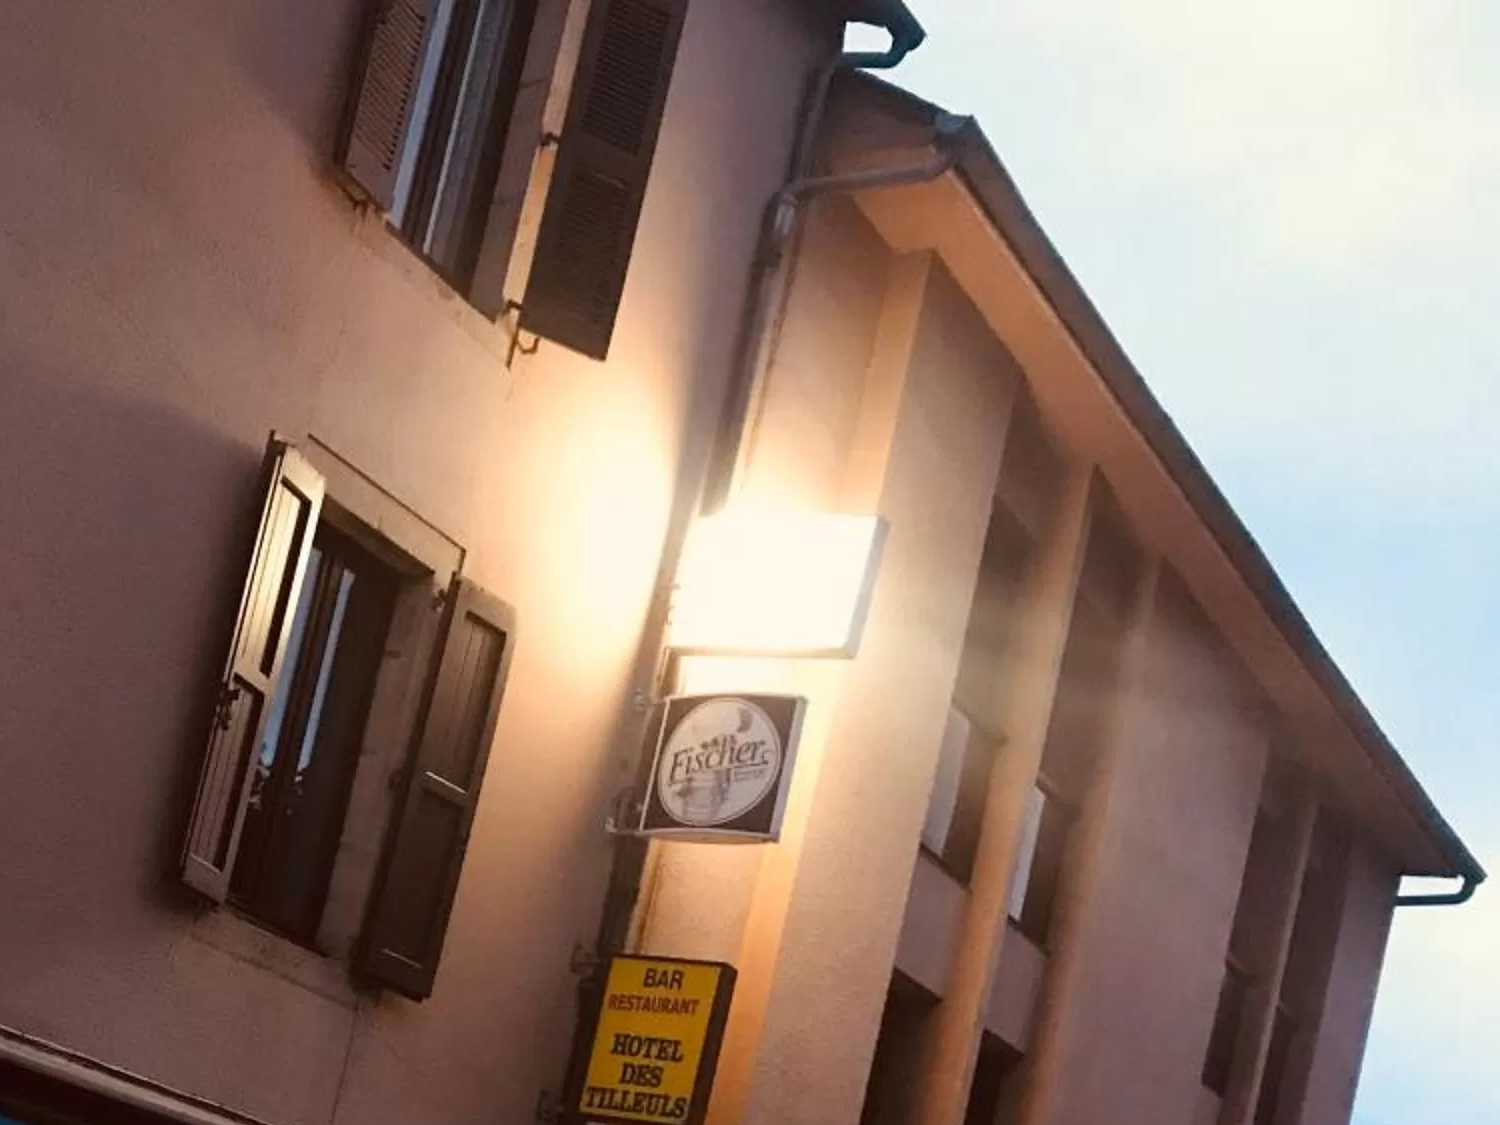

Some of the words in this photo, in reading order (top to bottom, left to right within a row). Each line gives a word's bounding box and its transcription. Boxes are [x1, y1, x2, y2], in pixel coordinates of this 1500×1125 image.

[668, 734, 764, 788] Fischer
[644, 968, 684, 991] BAR
[608, 993, 701, 1016] RESTAURANT
[611, 1032, 684, 1062] HOTEL
[620, 1063, 664, 1088] DES
[585, 1086, 688, 1118] TILLEULS
